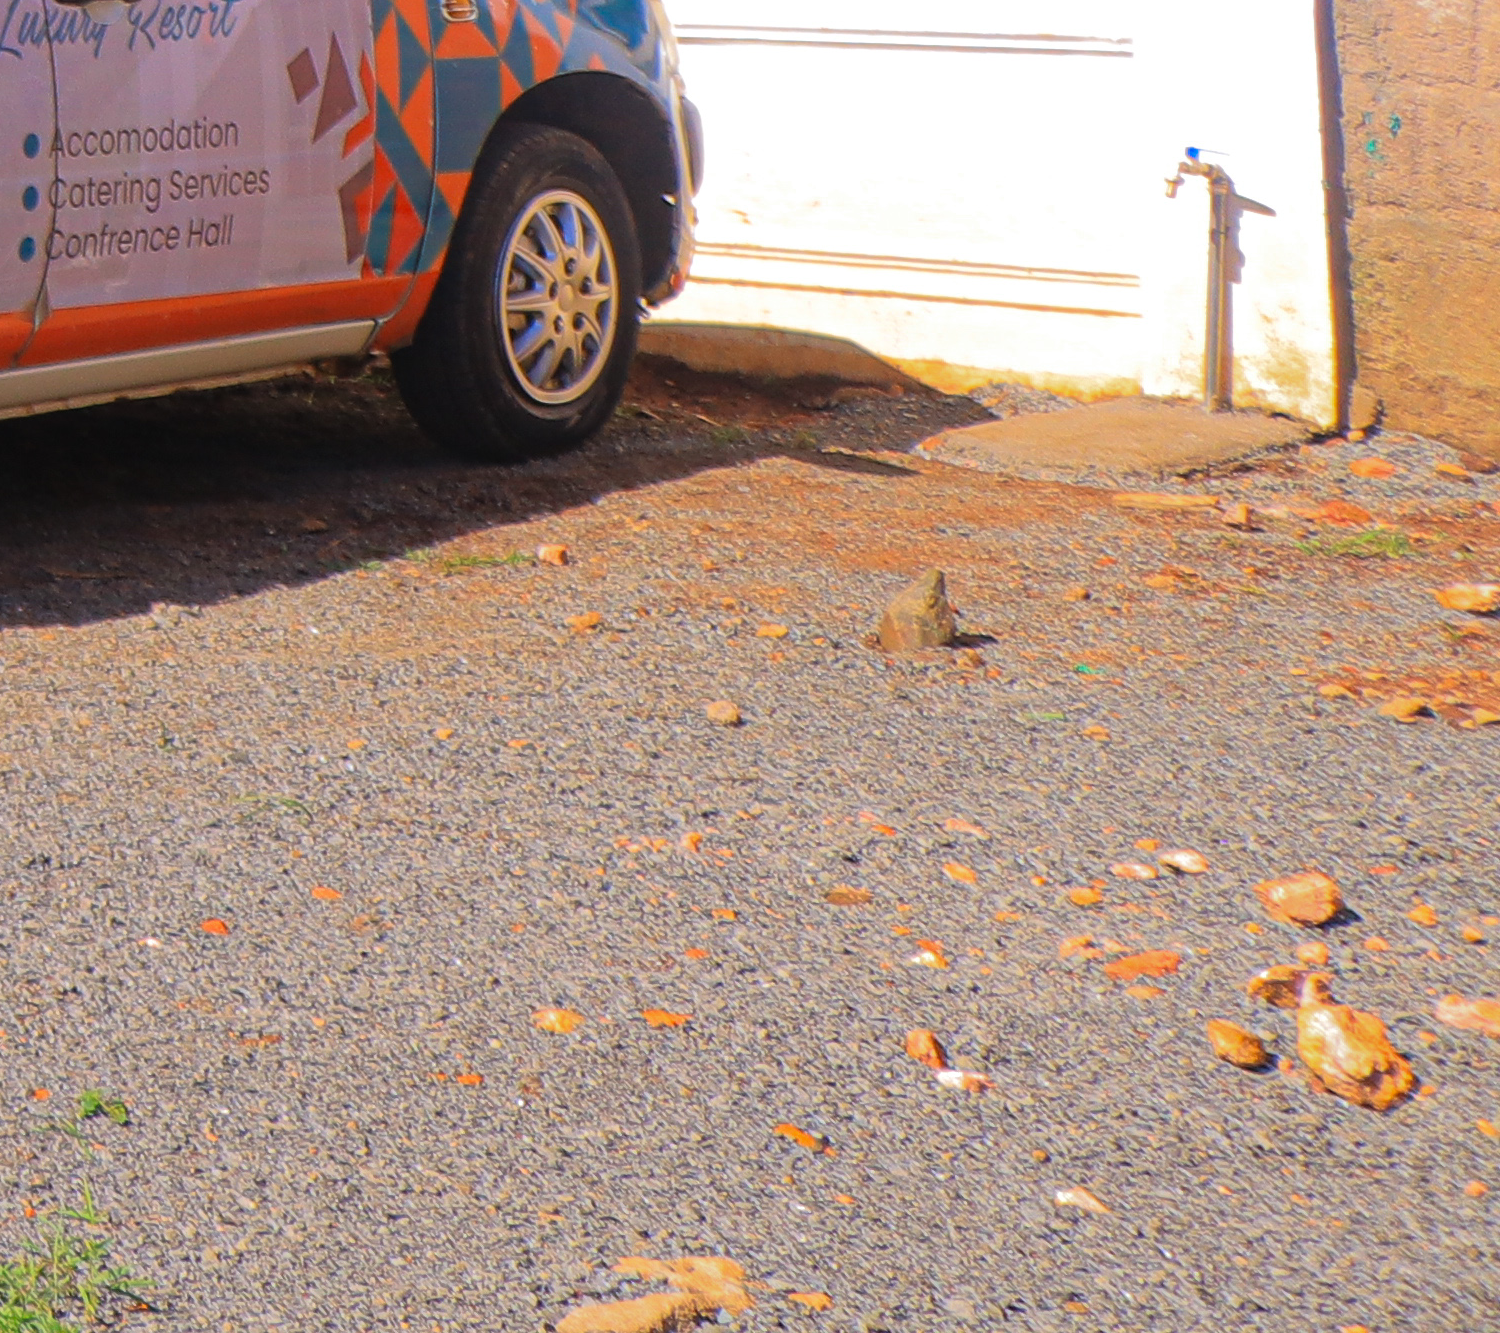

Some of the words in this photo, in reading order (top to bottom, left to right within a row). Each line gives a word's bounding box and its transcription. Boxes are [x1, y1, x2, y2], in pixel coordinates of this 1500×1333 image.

[50, 116, 239, 159] Accomodation
[49, 172, 162, 214] Catering
[169, 165, 271, 201] Services
[46, 223, 180, 261] Confrence
[187, 214, 234, 249] Hall
